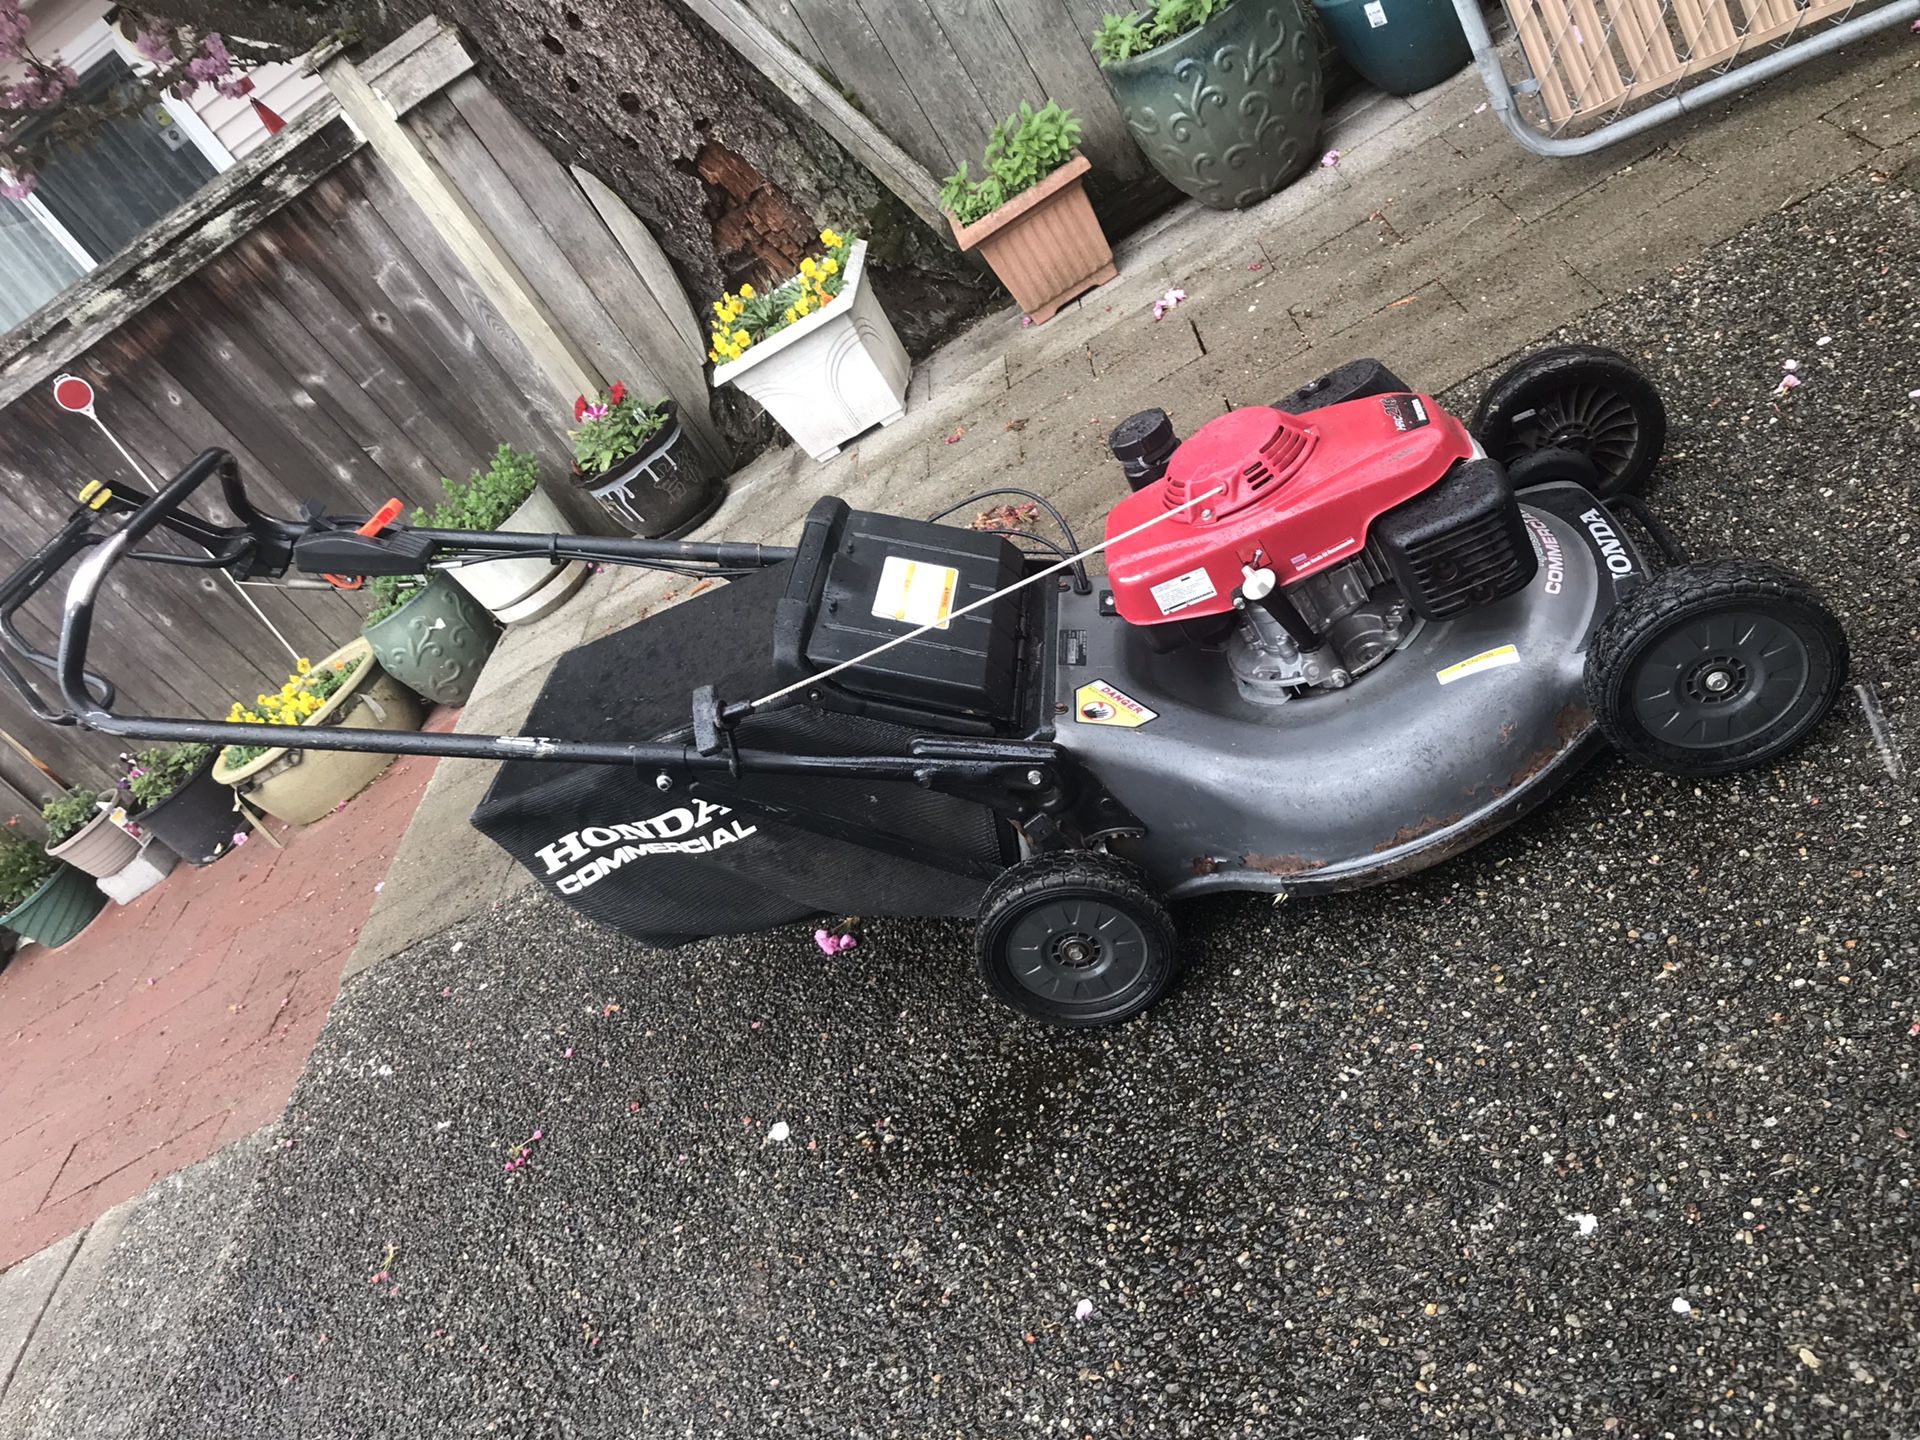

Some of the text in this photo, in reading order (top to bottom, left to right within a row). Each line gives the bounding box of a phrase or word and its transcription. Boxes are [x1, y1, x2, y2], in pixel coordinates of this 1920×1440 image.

[1520, 508, 1564, 594] COMMERCIA
[1101, 686, 1144, 715] DANGER
[534, 798, 733, 876] HONDA
[555, 819, 758, 895] COMMERCIAL
